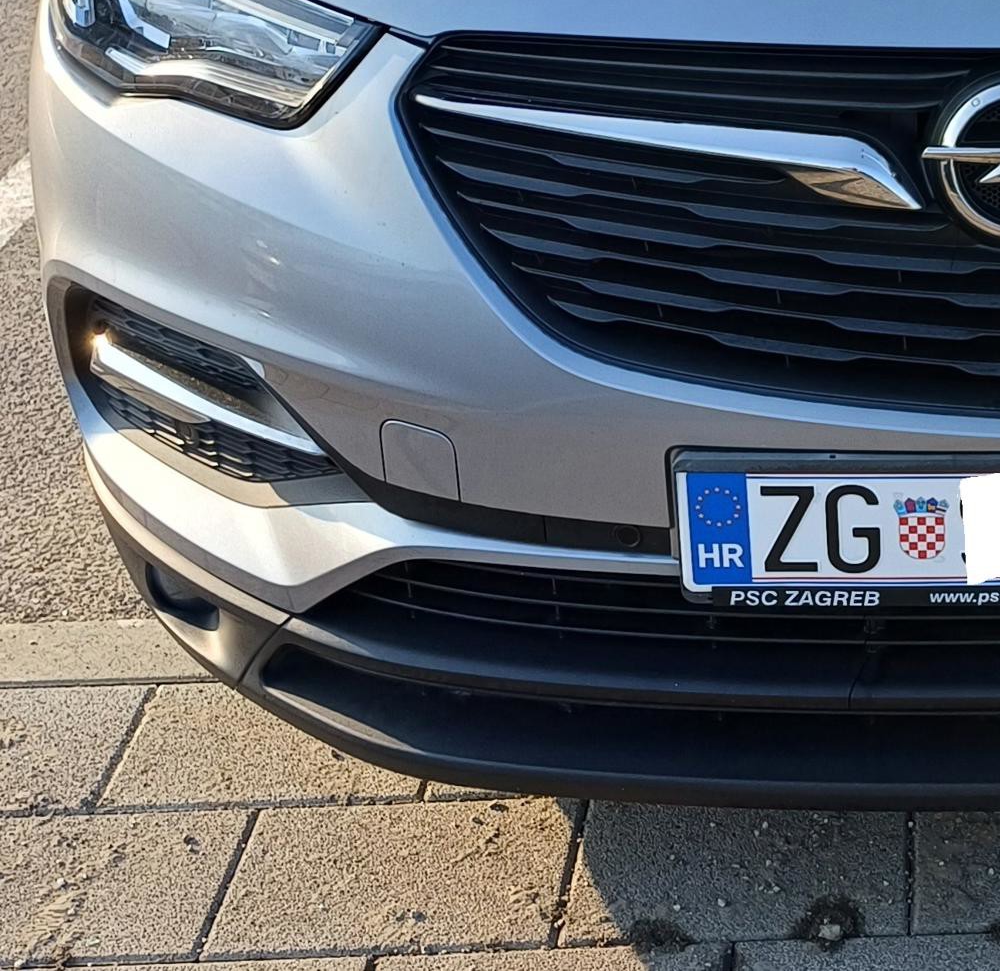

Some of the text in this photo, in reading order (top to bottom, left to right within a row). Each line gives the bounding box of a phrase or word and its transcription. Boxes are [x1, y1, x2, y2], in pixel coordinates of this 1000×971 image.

[760, 484, 881, 574] ZG
[697, 543, 745, 568] HR
[729, 590, 881, 607] PSC ZAGREB
